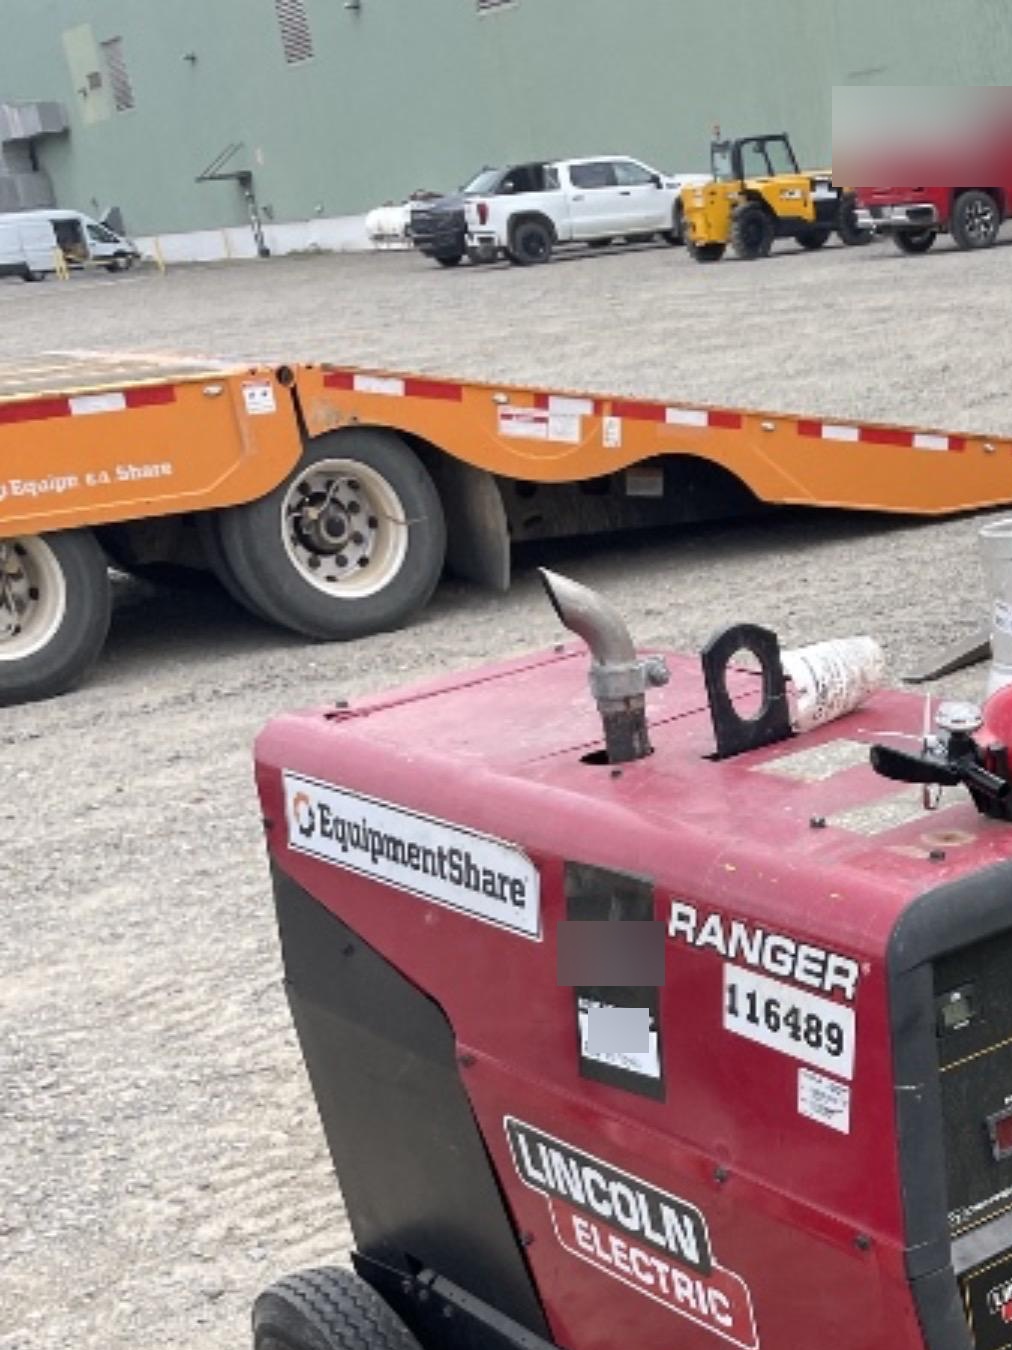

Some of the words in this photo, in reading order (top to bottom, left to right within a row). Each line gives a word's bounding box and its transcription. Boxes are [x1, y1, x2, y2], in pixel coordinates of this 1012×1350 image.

[317, 802, 526, 909] EquipmentShare
[668, 901, 859, 1000] RANGER
[727, 983, 845, 1057] 116489
[517, 1133, 700, 1265] LINCOLN
[571, 1213, 733, 1328] ELECTRIC
